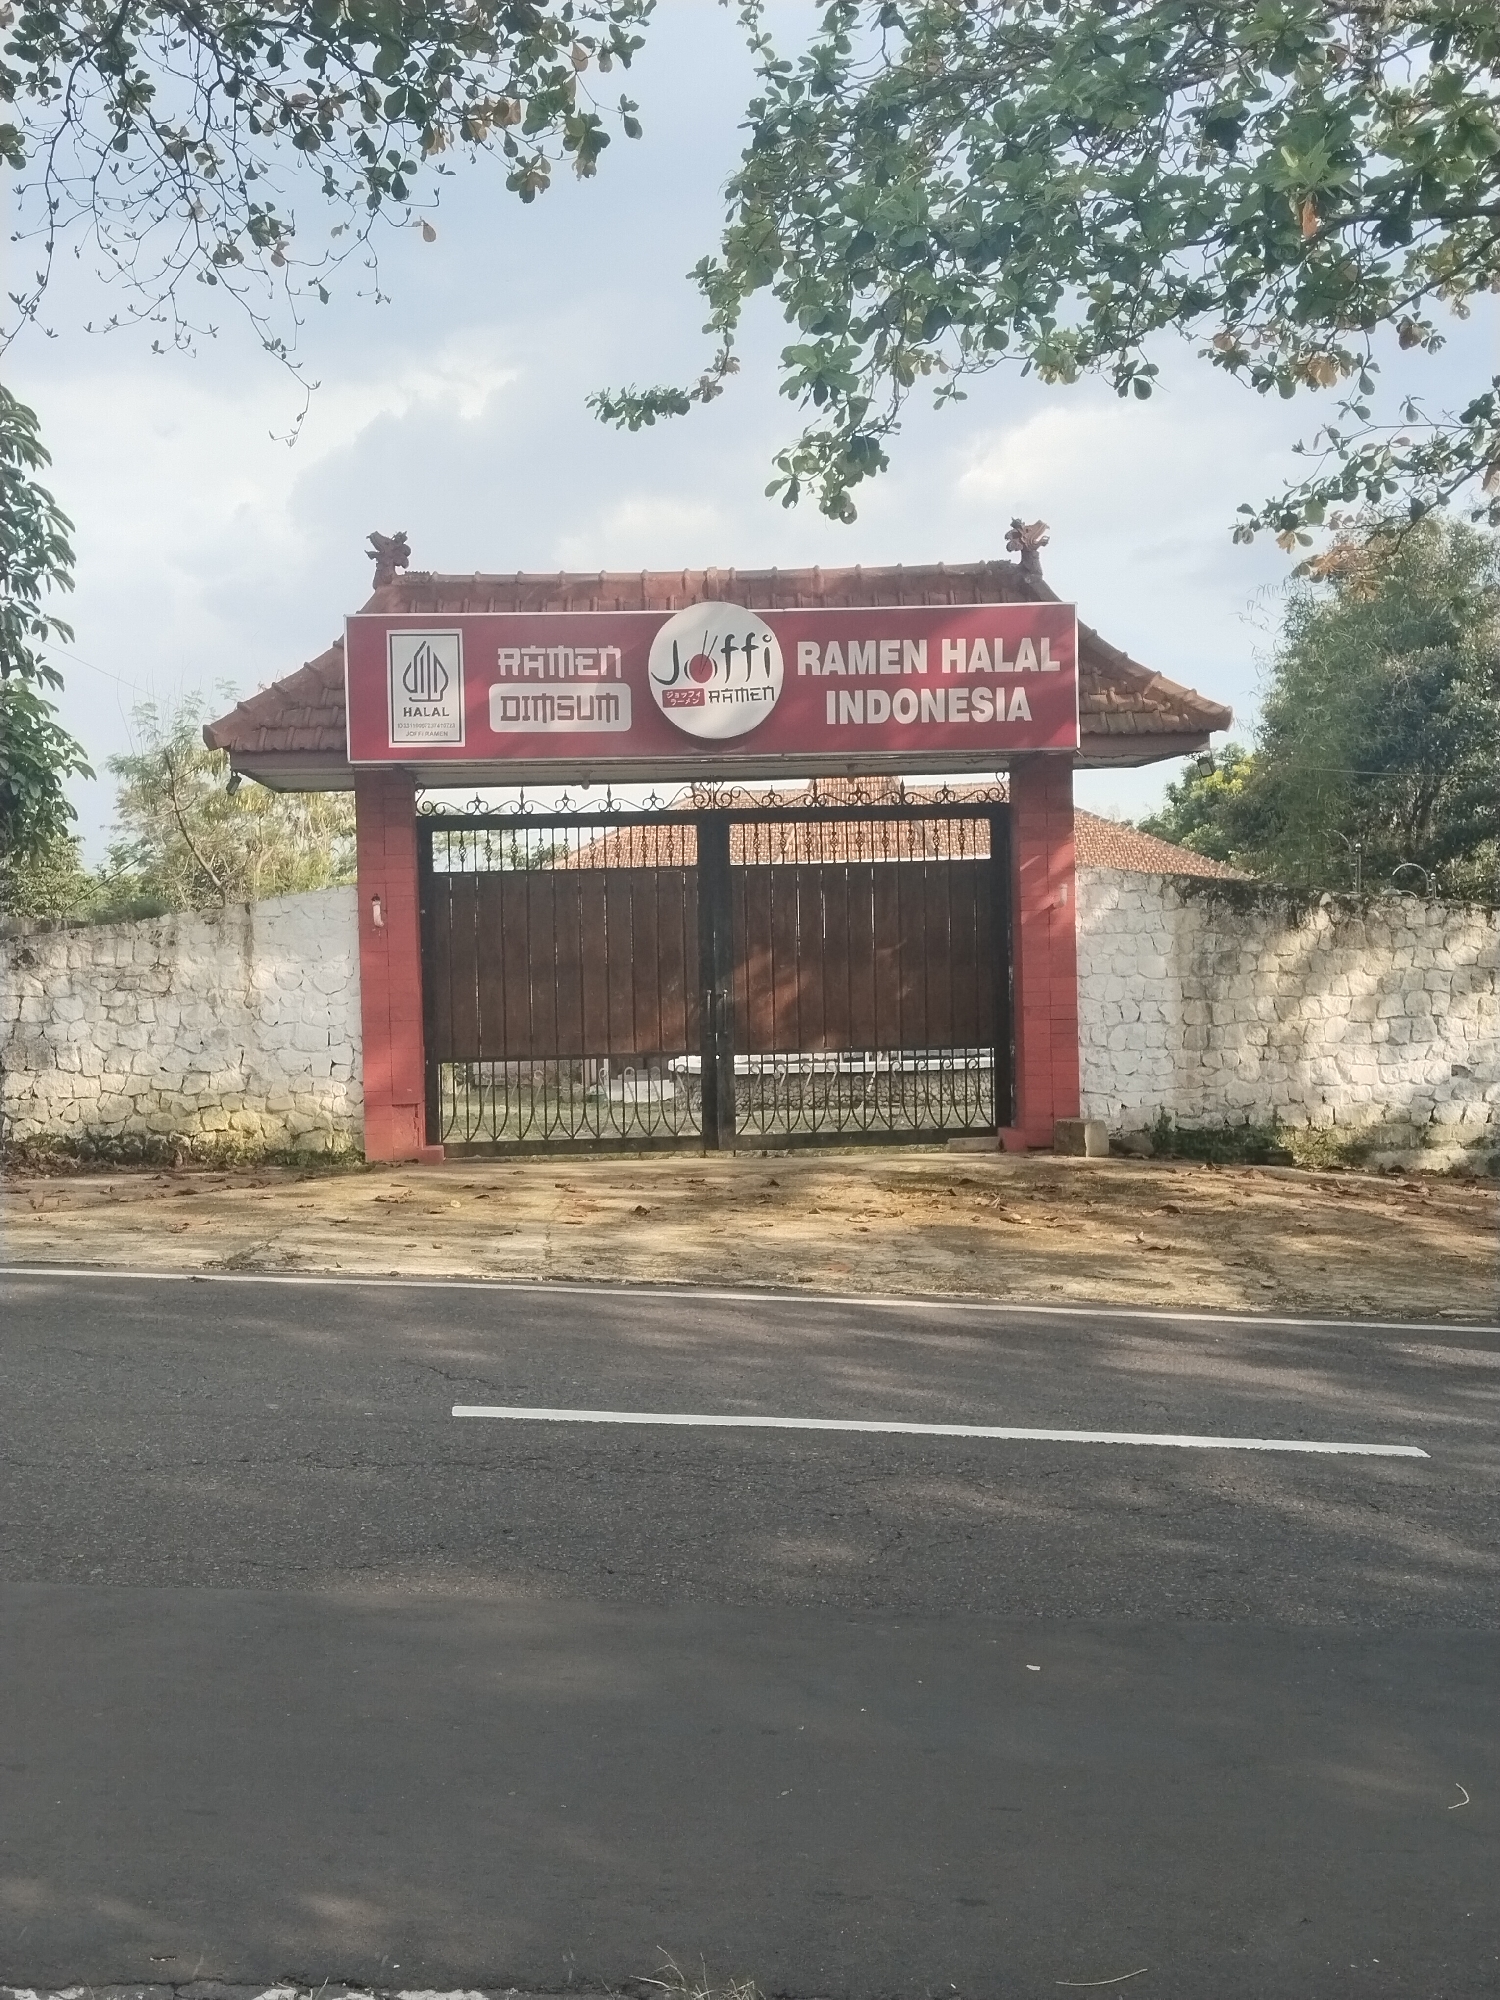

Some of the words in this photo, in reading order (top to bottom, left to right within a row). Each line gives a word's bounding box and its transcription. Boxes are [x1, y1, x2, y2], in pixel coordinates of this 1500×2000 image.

[498, 645, 622, 679] RAMEN
[650, 630, 773, 686] Joffi
[797, 639, 928, 676] RAMEN
[941, 637, 1061, 674] HALAL
[500, 693, 620, 724] DIMSUM
[670, 698, 700, 706] ラーメン
[708, 686, 775, 704] RAMEN
[826, 686, 1033, 725] INDONESIA
[403, 707, 449, 717] HALAL
